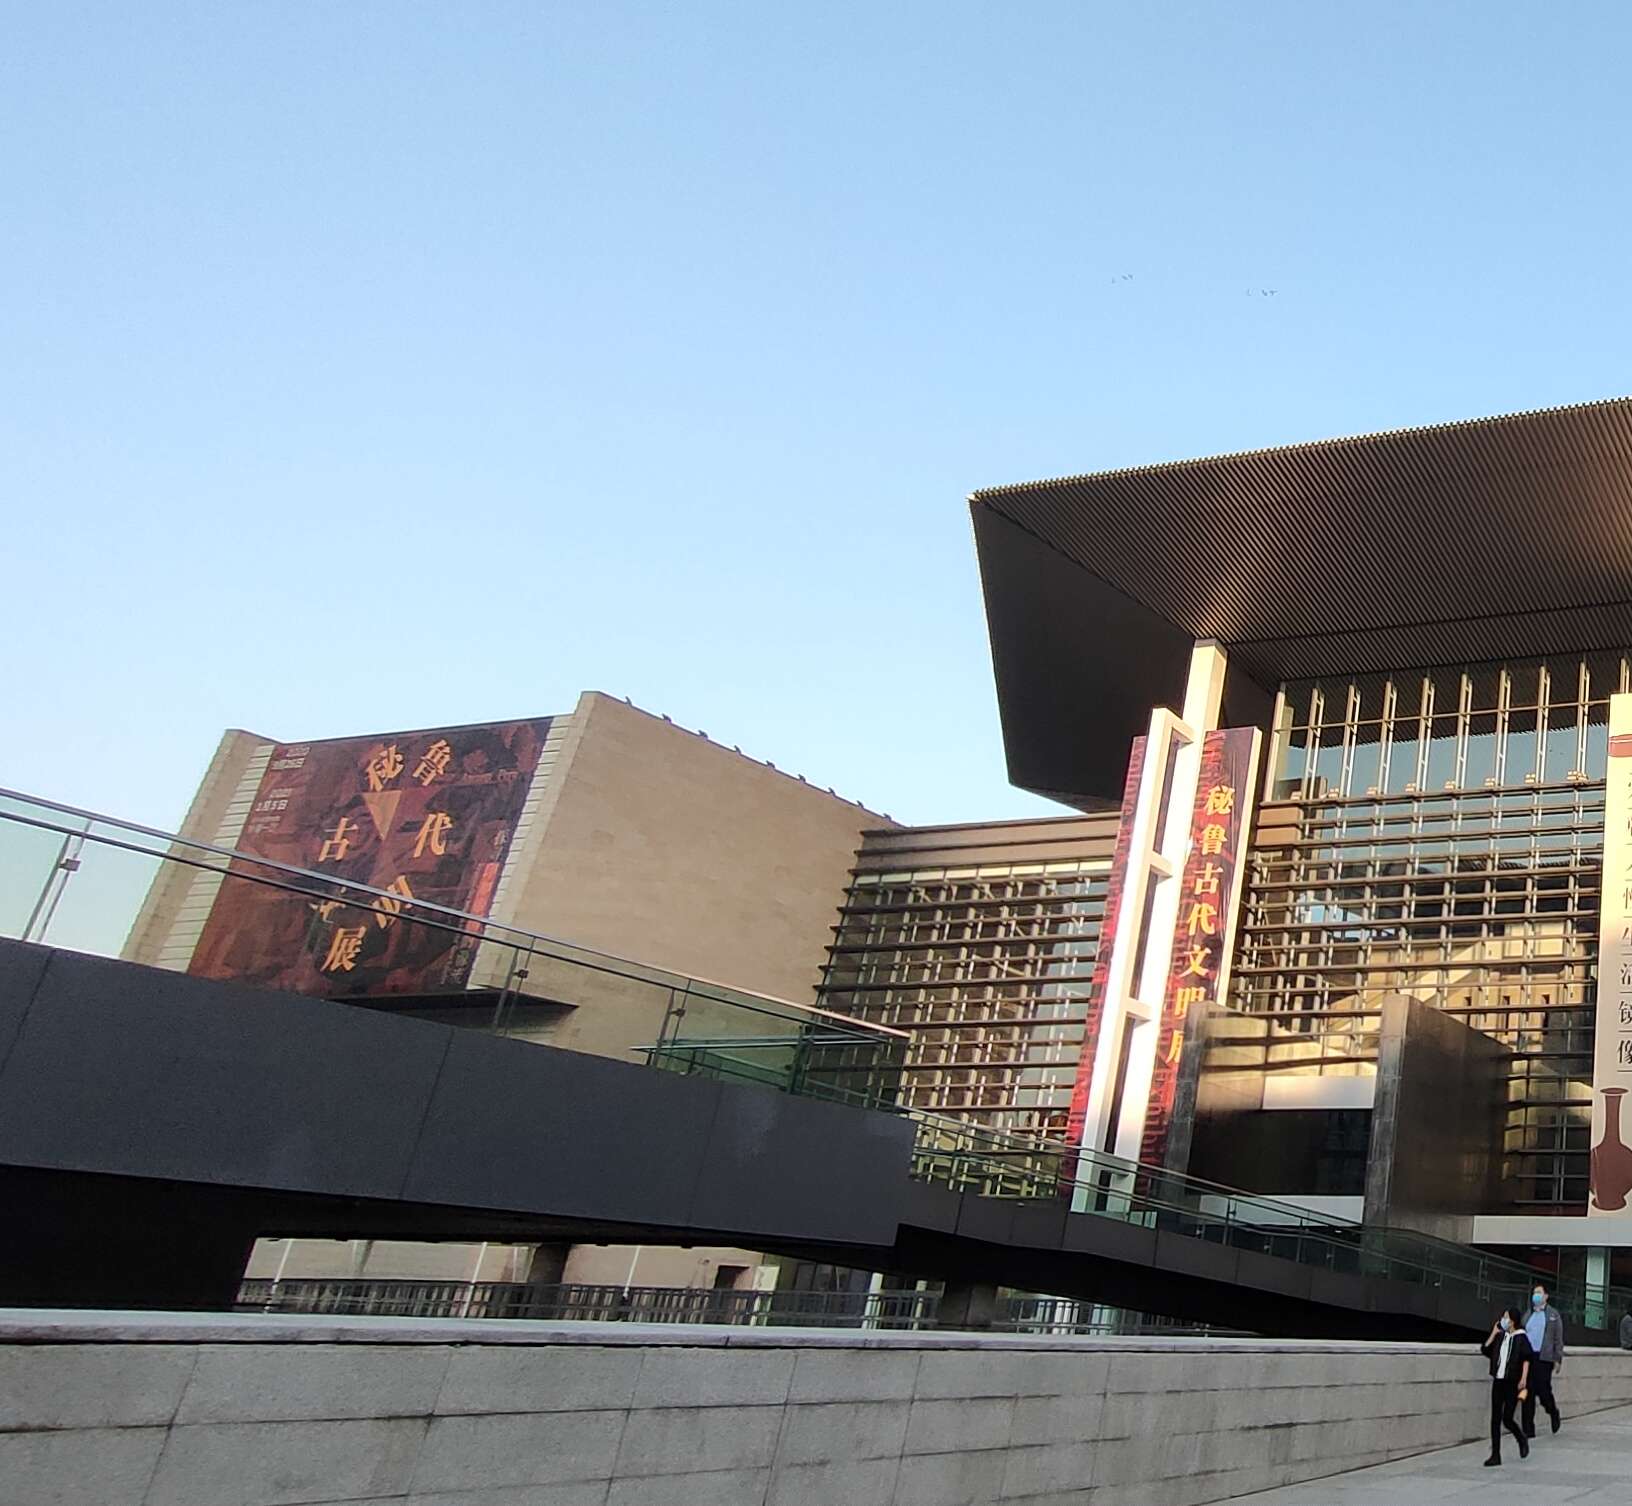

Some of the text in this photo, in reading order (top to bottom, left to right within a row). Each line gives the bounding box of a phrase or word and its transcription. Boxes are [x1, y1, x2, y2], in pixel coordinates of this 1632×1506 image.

[366, 740, 451, 792] 秘鲁
[318, 813, 452, 862] 古代
[320, 926, 367, 972] 展
